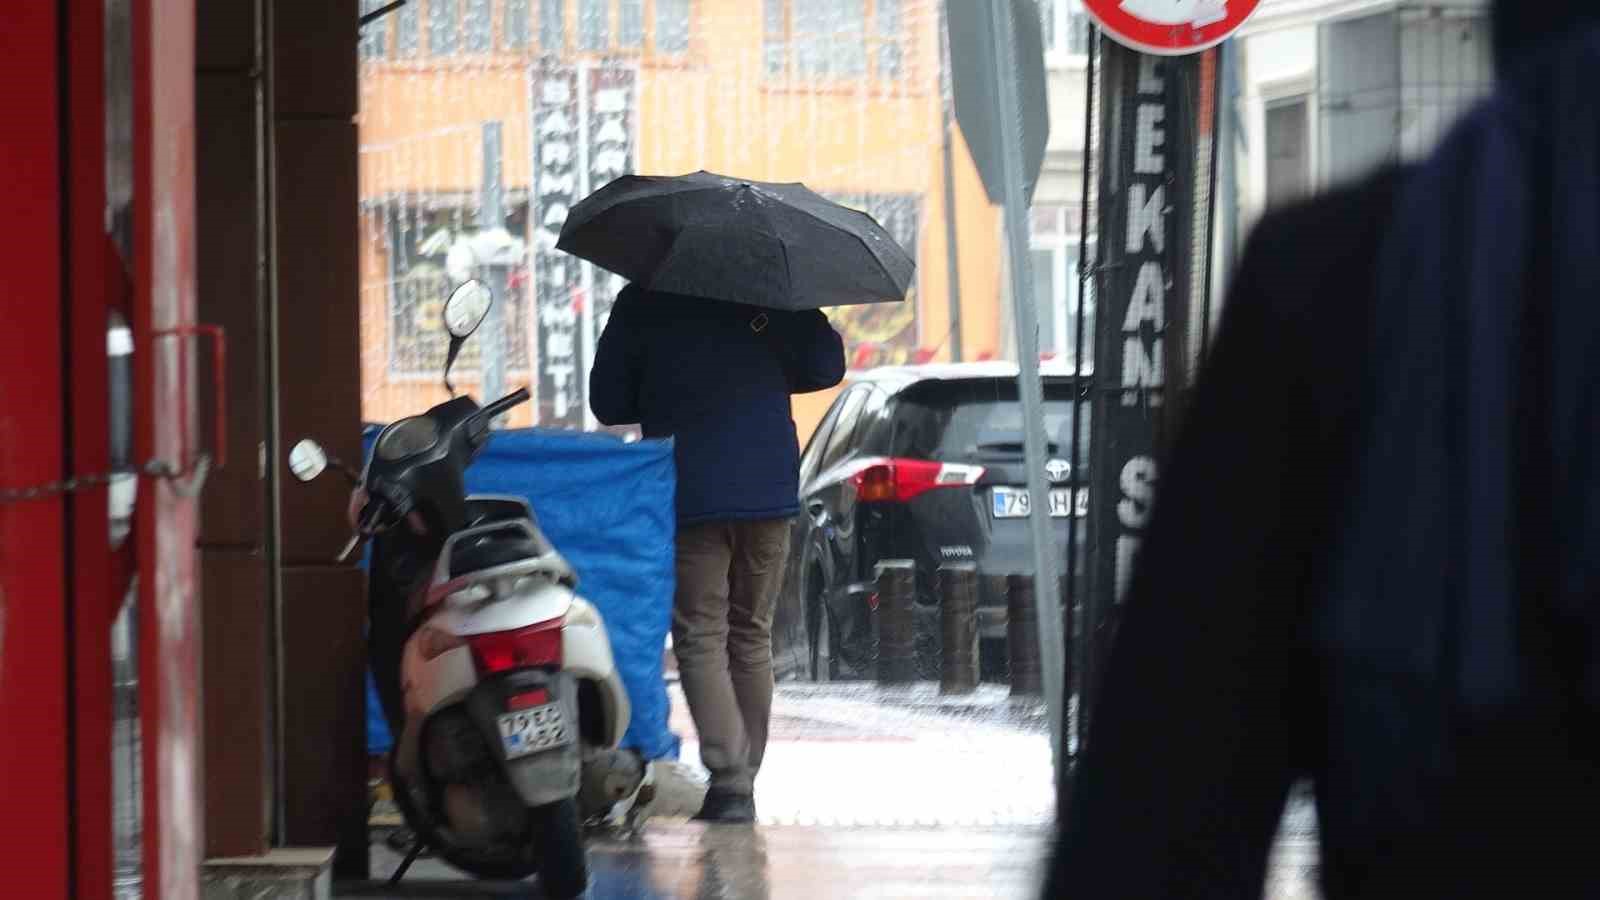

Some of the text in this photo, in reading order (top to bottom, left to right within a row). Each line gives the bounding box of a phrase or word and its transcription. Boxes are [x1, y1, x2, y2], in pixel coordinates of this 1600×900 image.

[1006, 493, 1029, 514] 79
[941, 546, 973, 558] TOYOTA
[501, 714, 529, 735] 79
